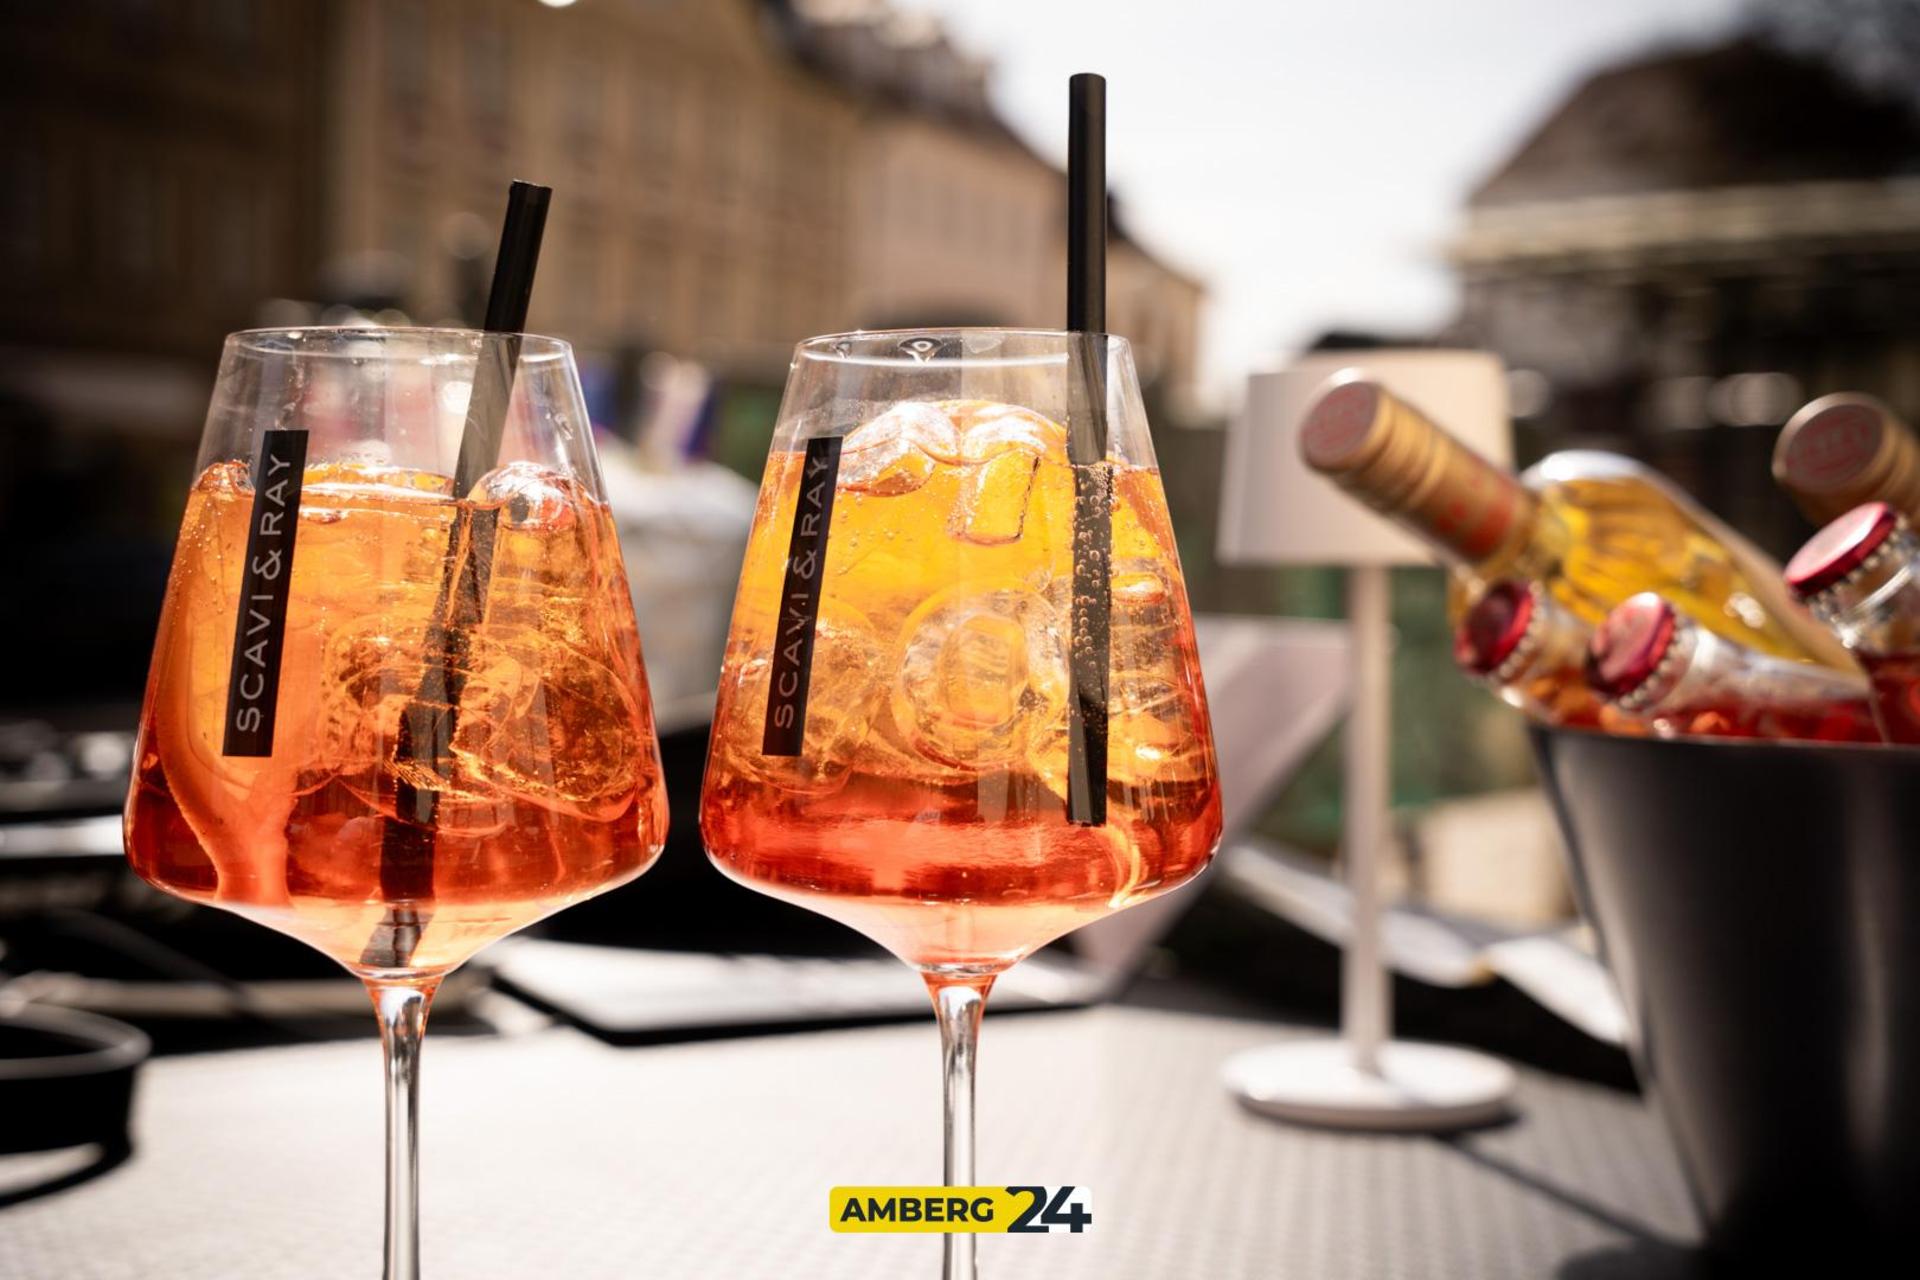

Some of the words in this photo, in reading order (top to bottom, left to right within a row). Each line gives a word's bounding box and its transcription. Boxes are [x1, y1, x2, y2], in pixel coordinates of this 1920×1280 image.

[259, 454, 291, 536] RAY
[800, 456, 829, 537] RAY
[252, 549, 282, 580] &
[793, 550, 817, 579] &
[236, 594, 274, 732] SCAVI
[774, 592, 809, 729] SCAVI
